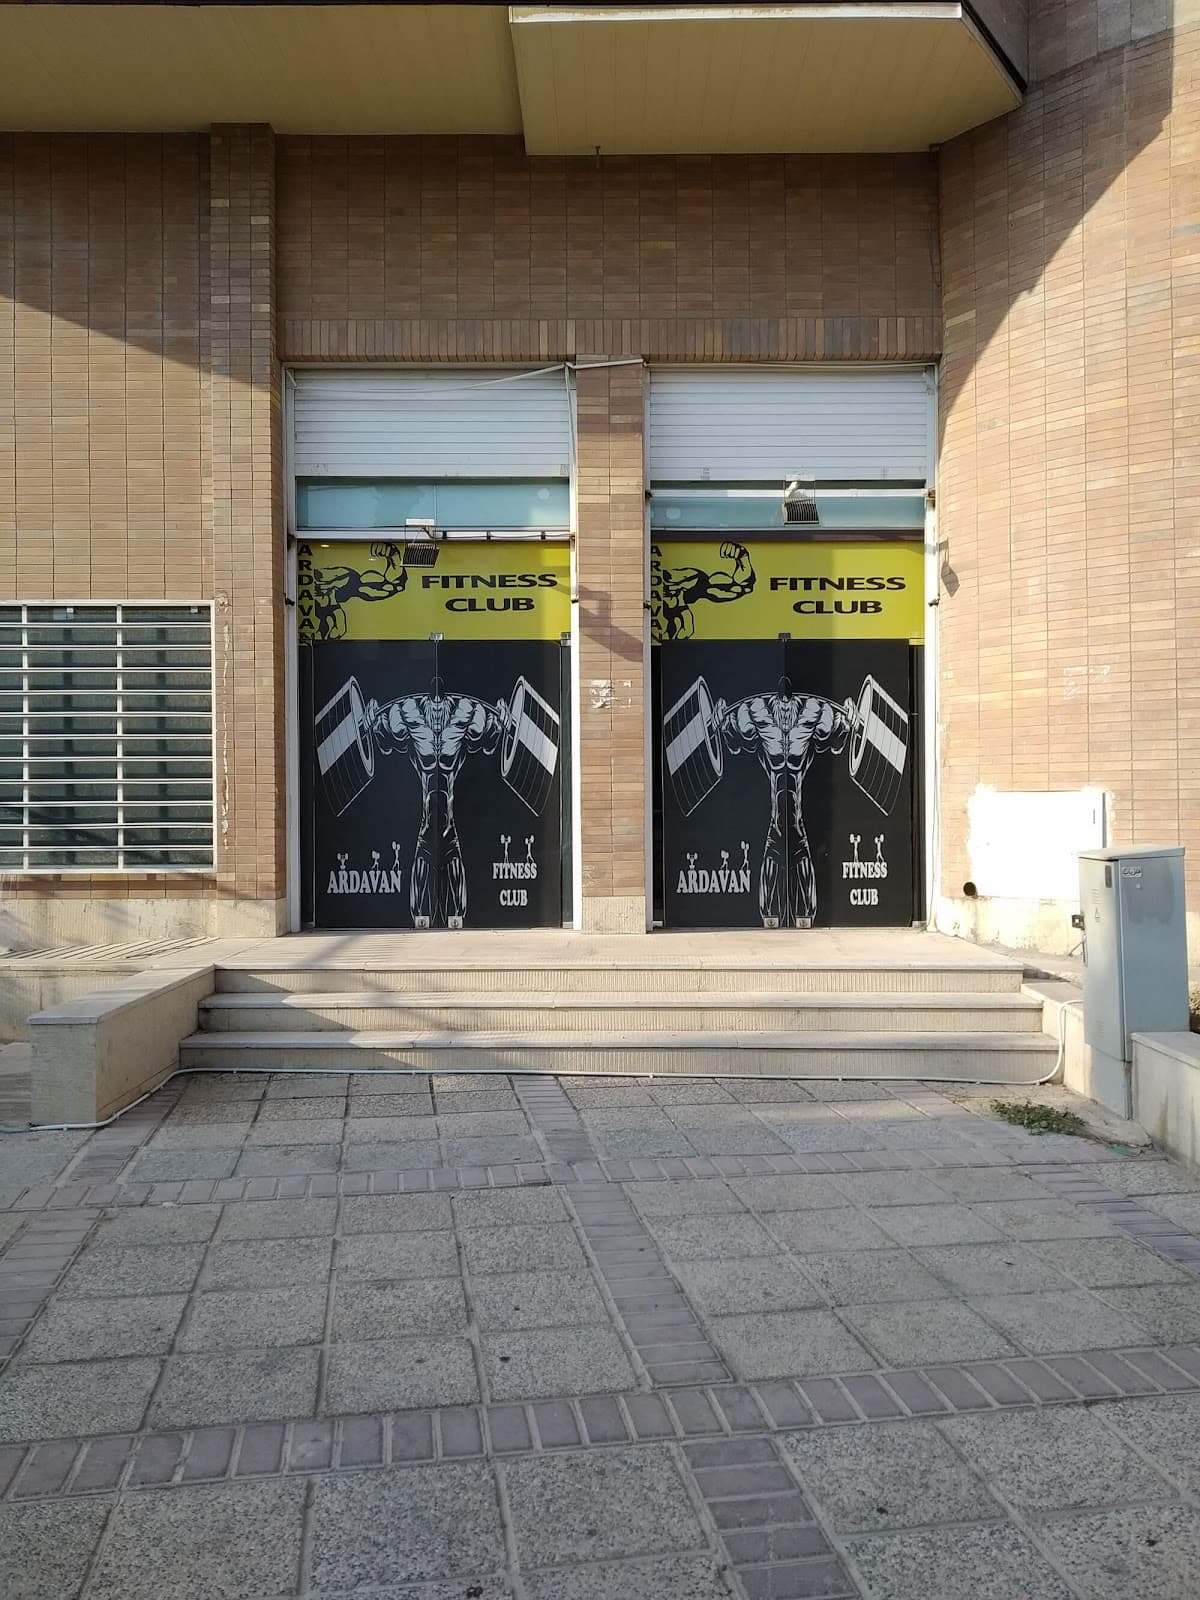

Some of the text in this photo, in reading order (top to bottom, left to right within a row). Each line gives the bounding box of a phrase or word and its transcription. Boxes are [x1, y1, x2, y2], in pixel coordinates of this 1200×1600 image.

[421, 573, 558, 589] FITNESS
[769, 576, 906, 591] FITNESS
[445, 597, 535, 612] CLUB
[792, 600, 883, 614] CLUB
[492, 862, 538, 880] FITNESS
[842, 861, 888, 879] FITNESS
[326, 869, 402, 894] ARDAVAN
[676, 869, 751, 894] ARDAVAN
[500, 889, 528, 906] CLUB
[850, 888, 879, 906] CLUB
